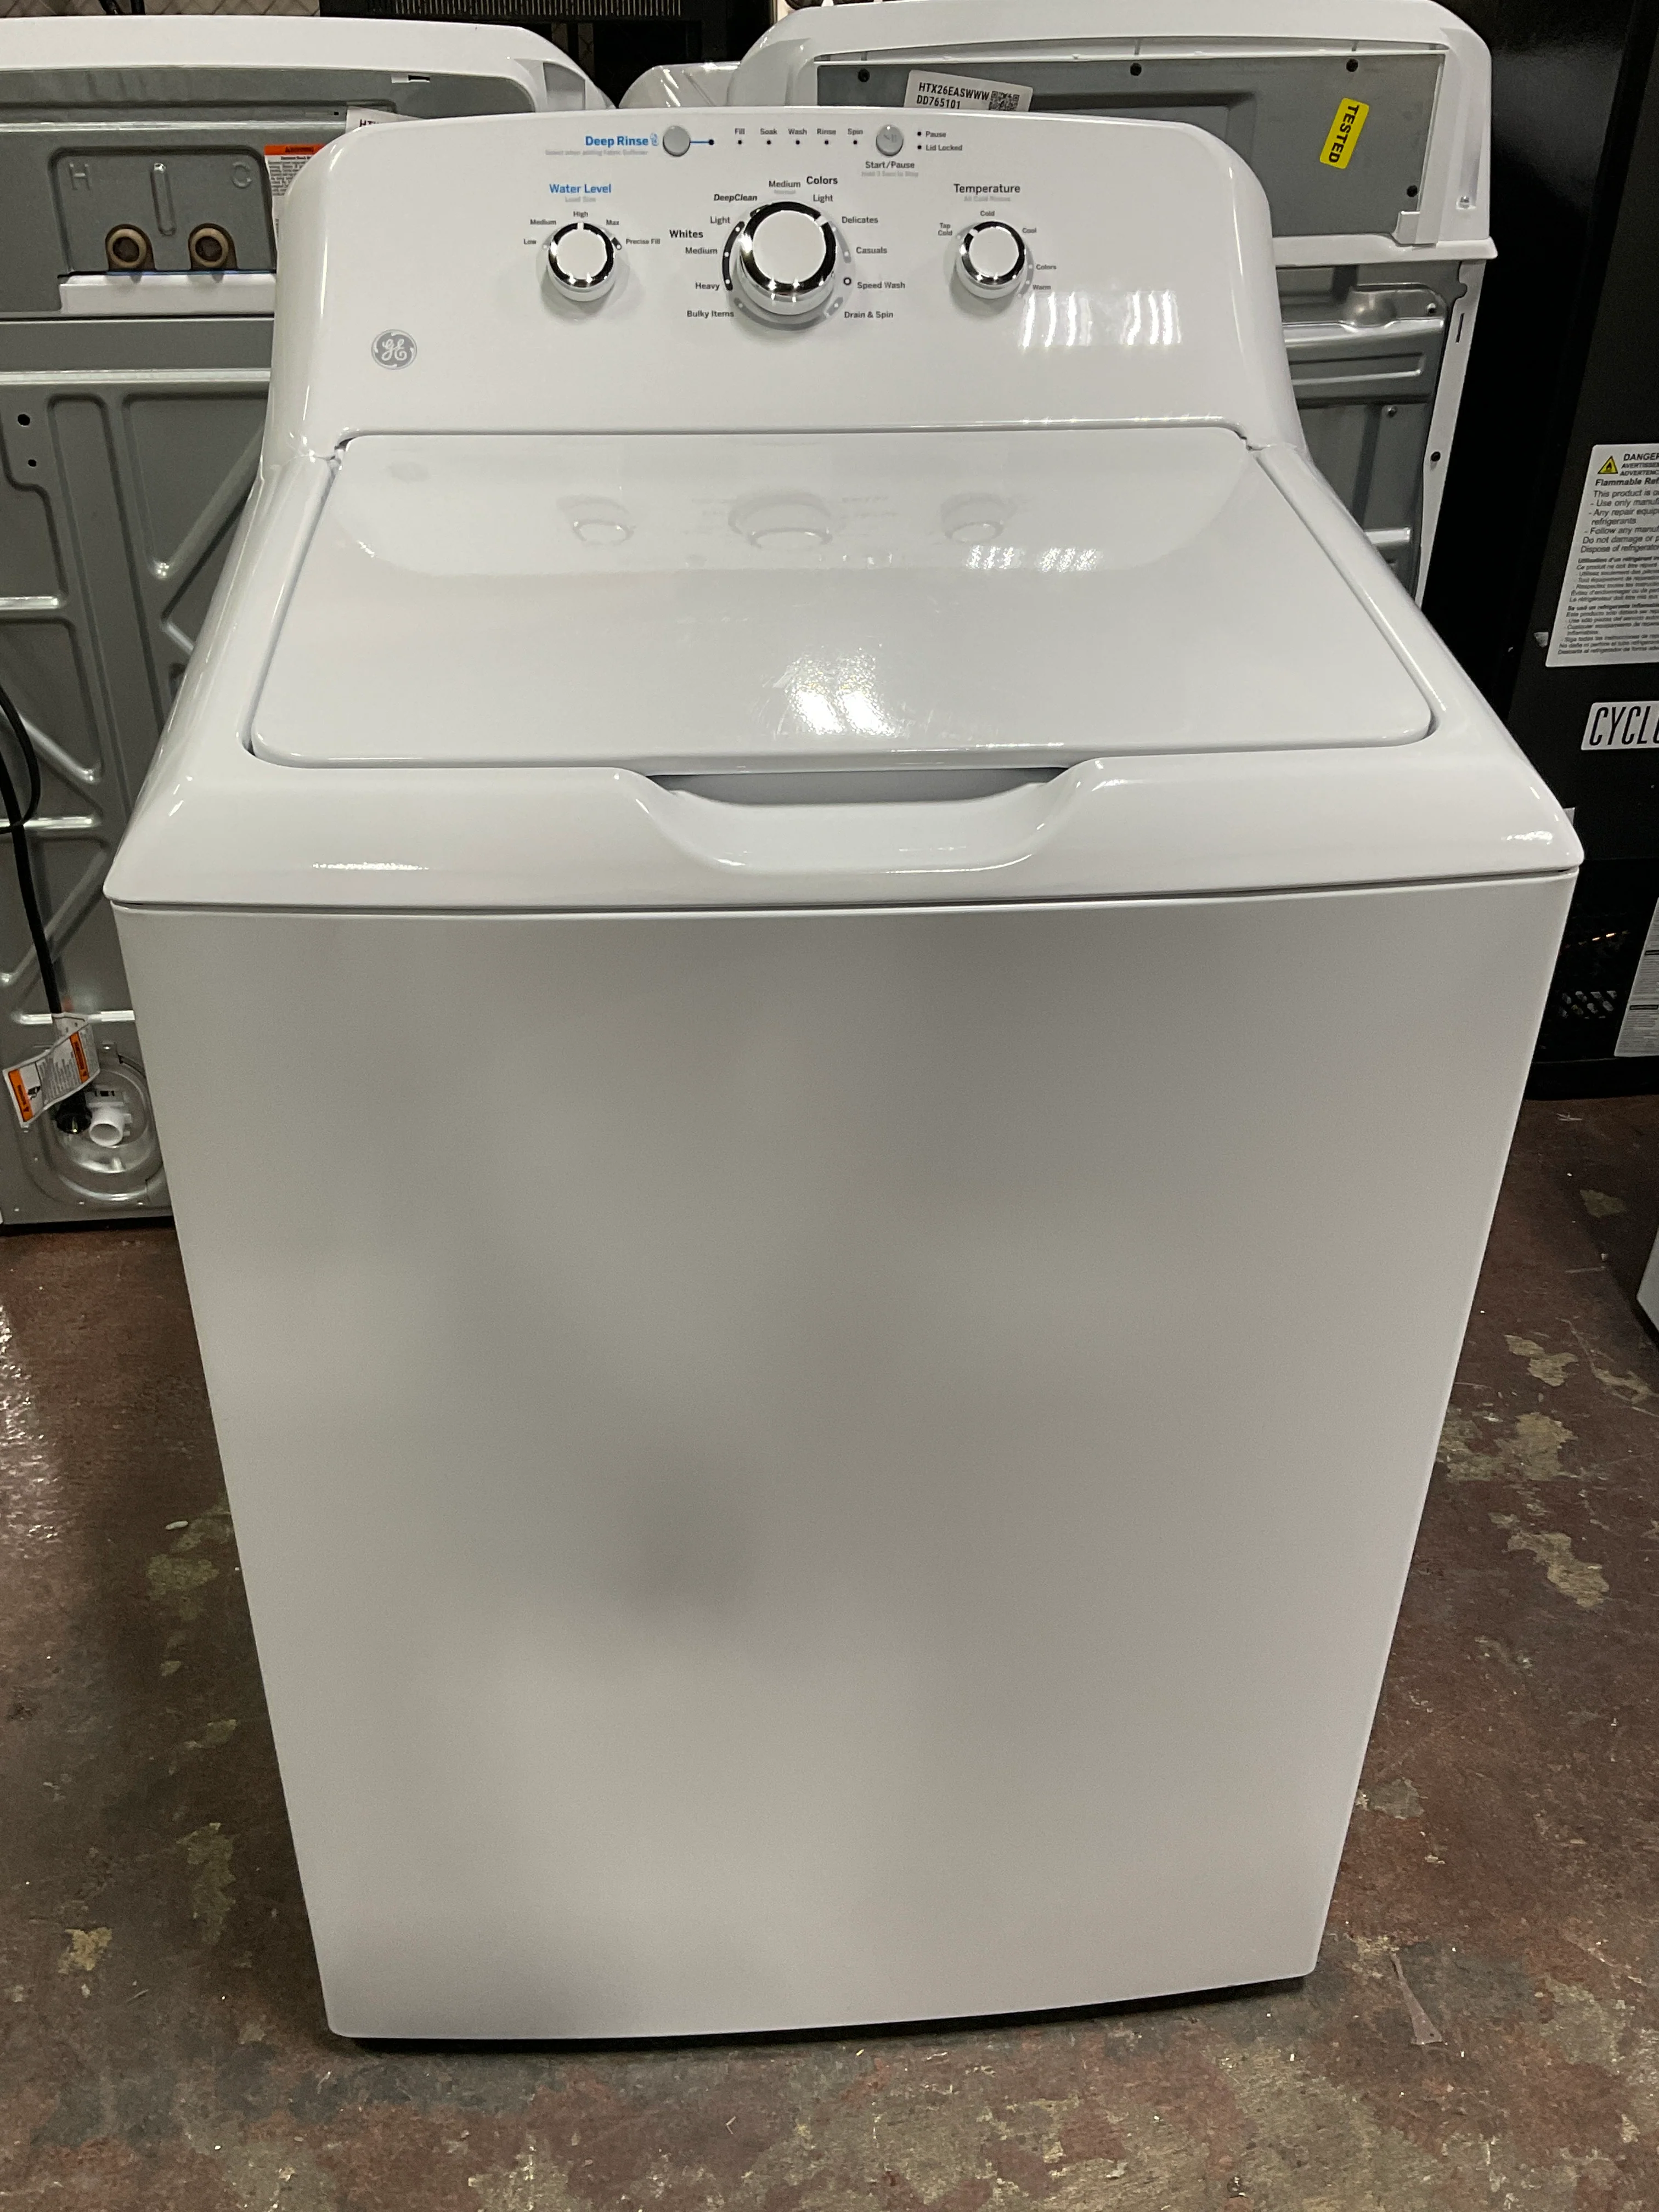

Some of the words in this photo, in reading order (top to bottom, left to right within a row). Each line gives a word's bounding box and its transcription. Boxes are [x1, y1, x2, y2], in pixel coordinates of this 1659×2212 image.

[918, 82, 990, 100] HTX26EASWWW
[916, 94, 961, 109] DD765101
[1329, 105, 1359, 162] TESTED
[585, 136, 614, 148] Deep
[617, 136, 648, 146] Rinse
[806, 176, 838, 184] Colors
[549, 183, 582, 193] Water
[584, 183, 612, 193] Level
[953, 184, 1020, 195] Temperature
[713, 194, 758, 202] DeepClean
[812, 194, 833, 204] Light
[710, 216, 731, 225] Light
[669, 230, 704, 238] Whites
[695, 282, 720, 291] Heavy
[857, 281, 882, 290] Speed
[687, 310, 709, 319] Bulky
[876, 311, 894, 319] Spin
[1595, 478, 1642, 486] Flammable
[1612, 489, 1642, 498] product
[1614, 499, 1632, 507] only
[1593, 509, 1610, 517] Any
[1611, 535, 1643, 544] damage
